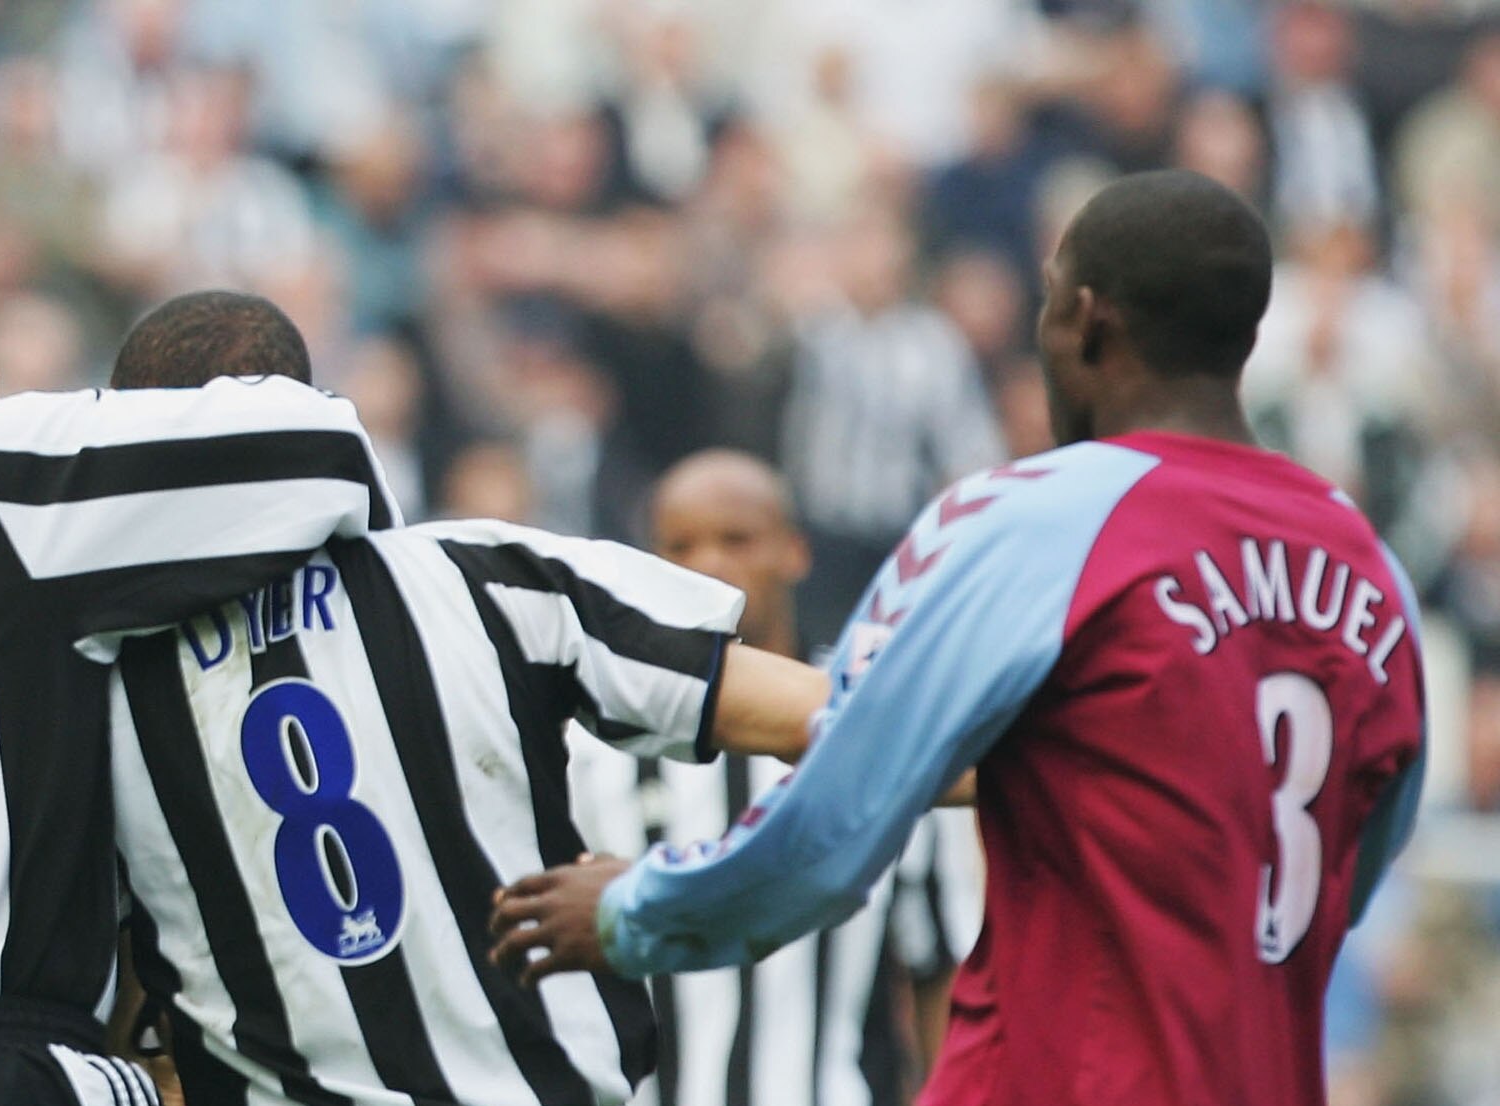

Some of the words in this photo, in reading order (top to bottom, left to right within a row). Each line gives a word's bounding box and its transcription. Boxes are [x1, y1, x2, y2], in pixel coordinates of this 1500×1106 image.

[182, 566, 337, 671] DYER
[1155, 537, 1406, 684] SAMUEL
[240, 678, 404, 966] 8
[1255, 672, 1333, 964] 3
